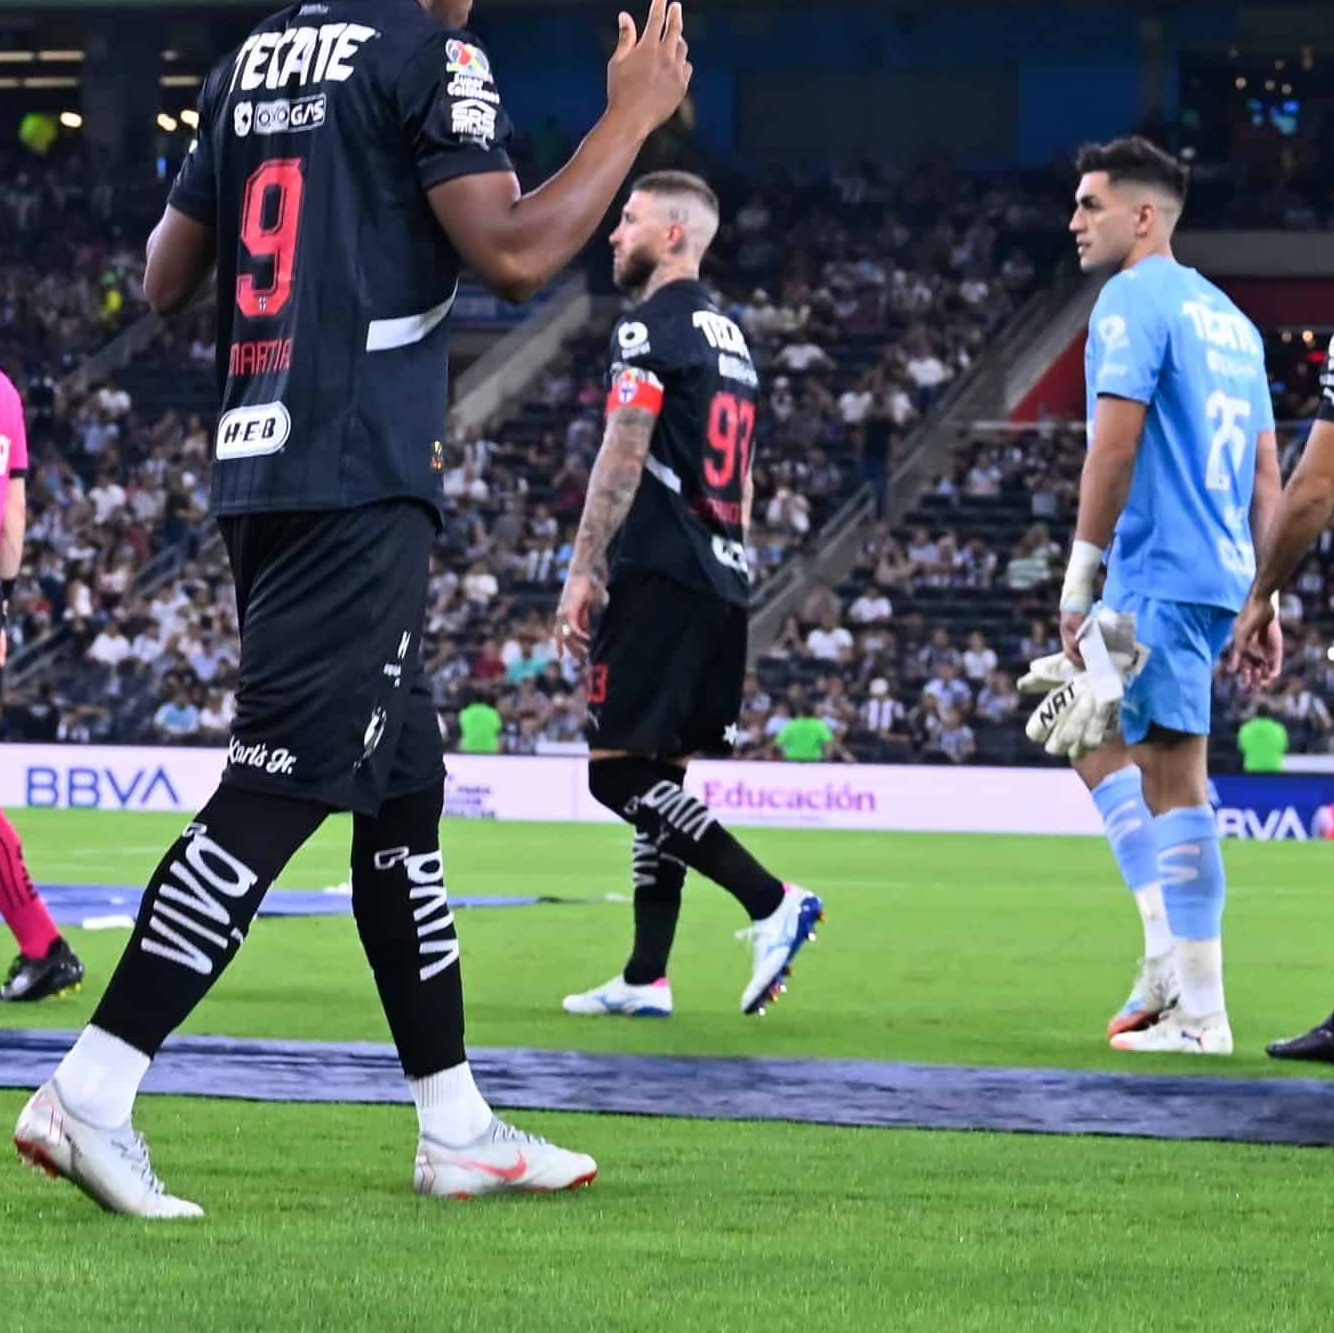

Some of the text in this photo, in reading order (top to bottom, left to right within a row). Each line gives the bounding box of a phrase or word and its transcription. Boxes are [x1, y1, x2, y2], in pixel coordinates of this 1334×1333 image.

[229, 22, 376, 93] TECATE
[236, 157, 303, 317] 9
[25, 766, 181, 807] BBVA
[704, 779, 877, 812] Educación
